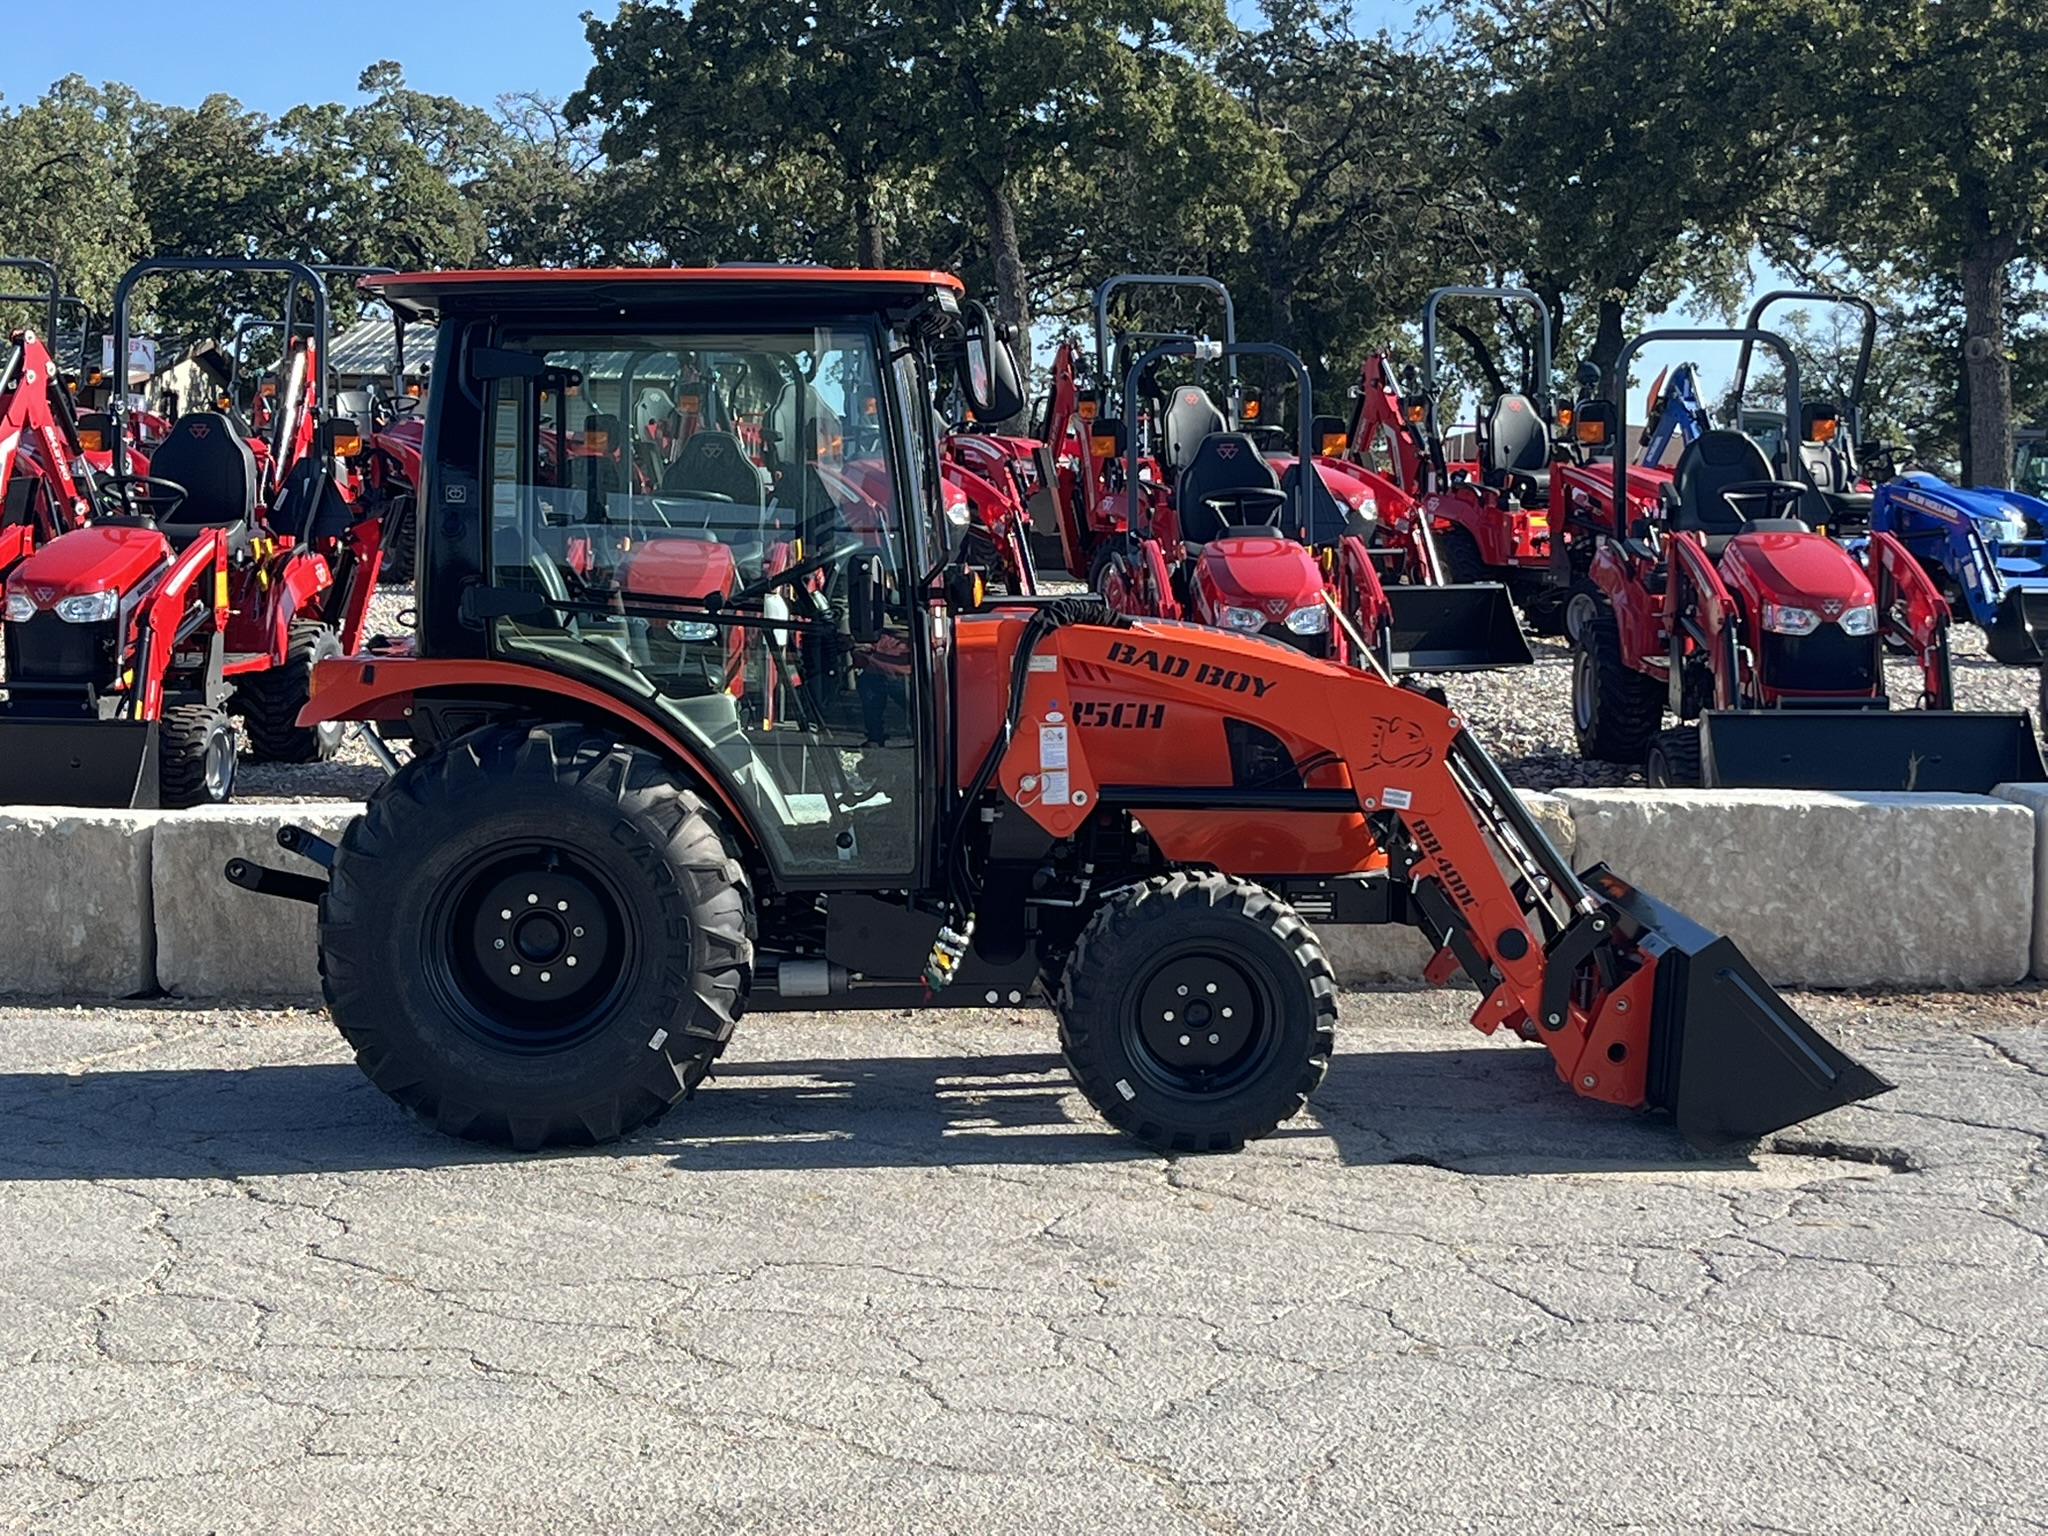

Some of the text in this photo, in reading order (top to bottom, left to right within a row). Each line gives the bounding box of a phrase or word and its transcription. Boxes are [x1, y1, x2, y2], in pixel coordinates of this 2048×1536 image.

[1106, 641, 1277, 698] BAD BOY
[609, 817, 692, 1021] CARLSTAR
